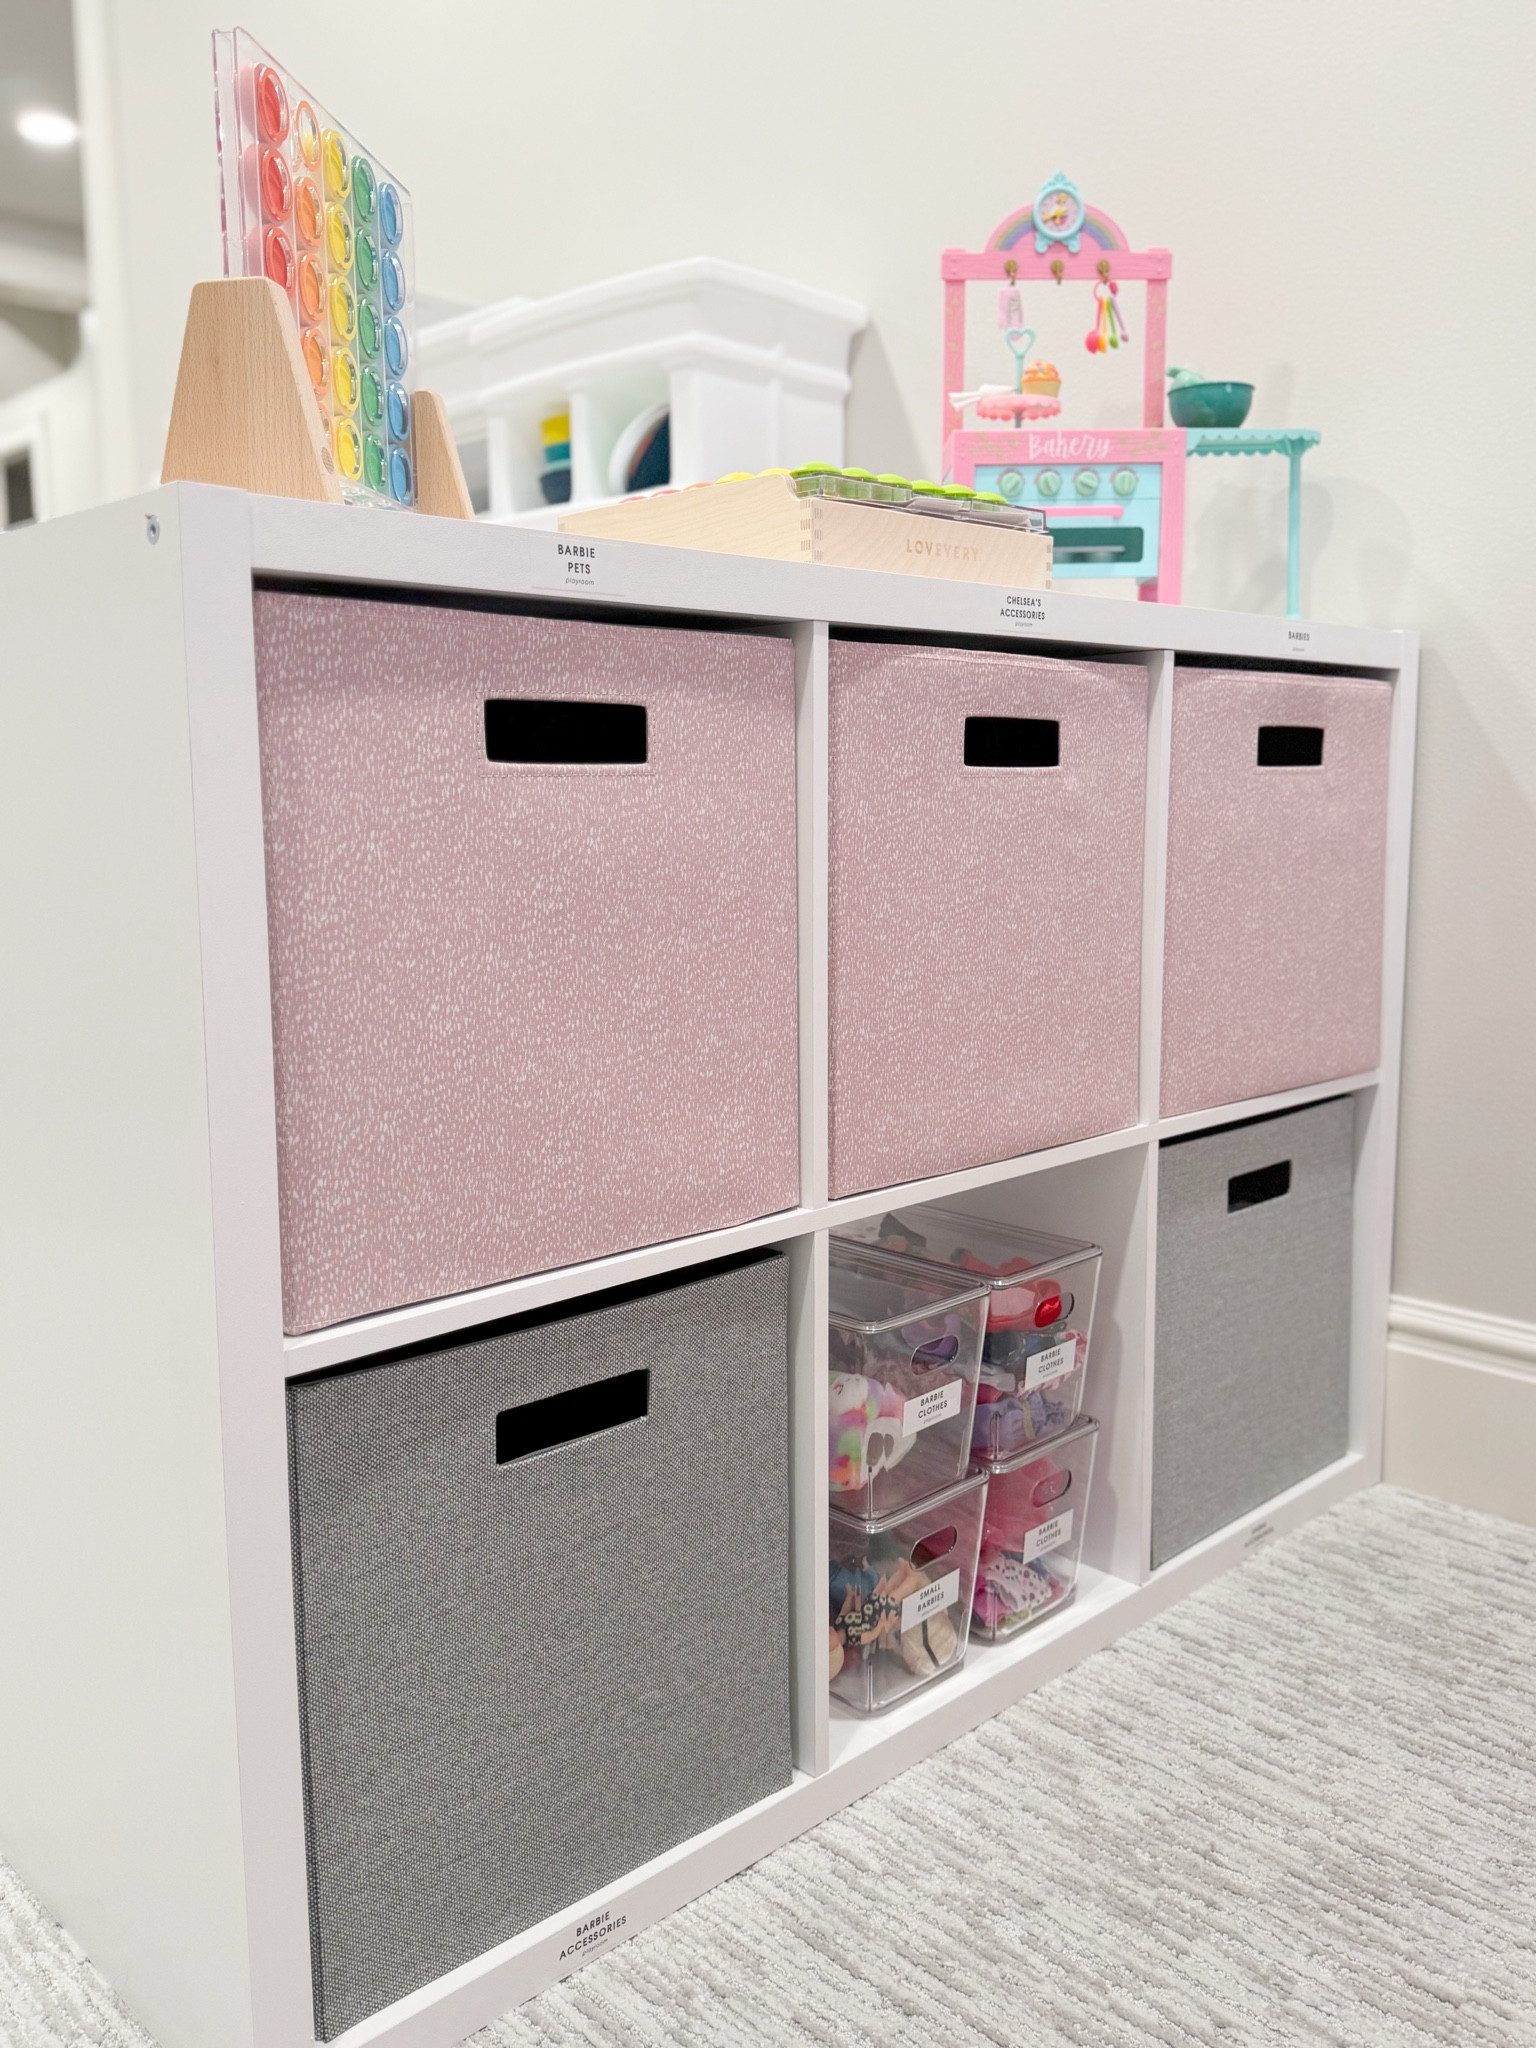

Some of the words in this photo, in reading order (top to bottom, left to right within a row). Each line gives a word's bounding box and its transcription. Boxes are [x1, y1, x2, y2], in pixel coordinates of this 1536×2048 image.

[1028, 429, 1111, 460] Bakery
[557, 543, 596, 559] BARBIE
[906, 538, 981, 561] LOVEVERY
[567, 561, 592, 575] PETS
[565, 577, 595, 586] playroom
[1006, 595, 1042, 608] CHELSEA'S
[999, 608, 1046, 621] ACCESSORIES
[1288, 631, 1310, 641] BARBIES
[1040, 1348, 1061, 1363] BARBIE
[1038, 1357, 1064, 1374] CLOTHES
[920, 1390, 944, 1407] BARBIE
[917, 1400, 948, 1419] CLOTHES
[919, 1583, 941, 1601] SMALL
[917, 1591, 945, 1613] BARBIES
[576, 1911, 610, 1937] BARBIE
[559, 1915, 627, 1961] ACCESSORIES
